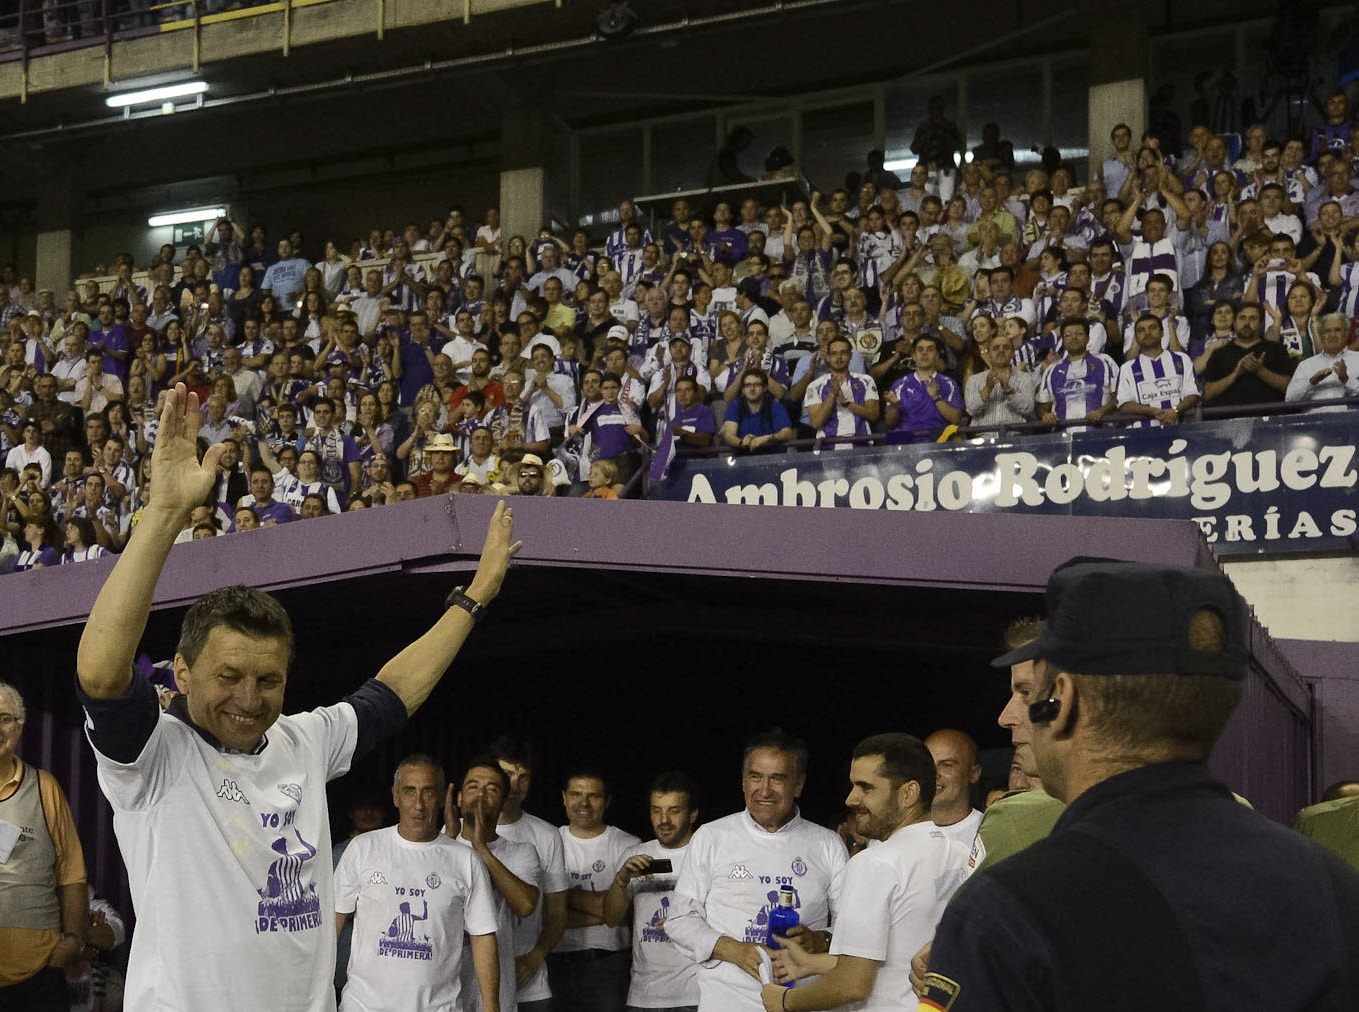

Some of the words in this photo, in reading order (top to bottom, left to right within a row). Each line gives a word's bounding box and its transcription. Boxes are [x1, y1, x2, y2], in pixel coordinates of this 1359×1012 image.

[995, 439, 1358, 510] Rodríguez
[687, 459, 972, 512] Ambrosio
[260, 813, 280, 828] YO
[283, 810, 297, 827] SOY
[570, 872, 580, 880] YO
[759, 876, 771, 885] YO
[776, 876, 794, 885] SOY
[395, 887, 406, 895] YO
[410, 888, 426, 897] SOY
